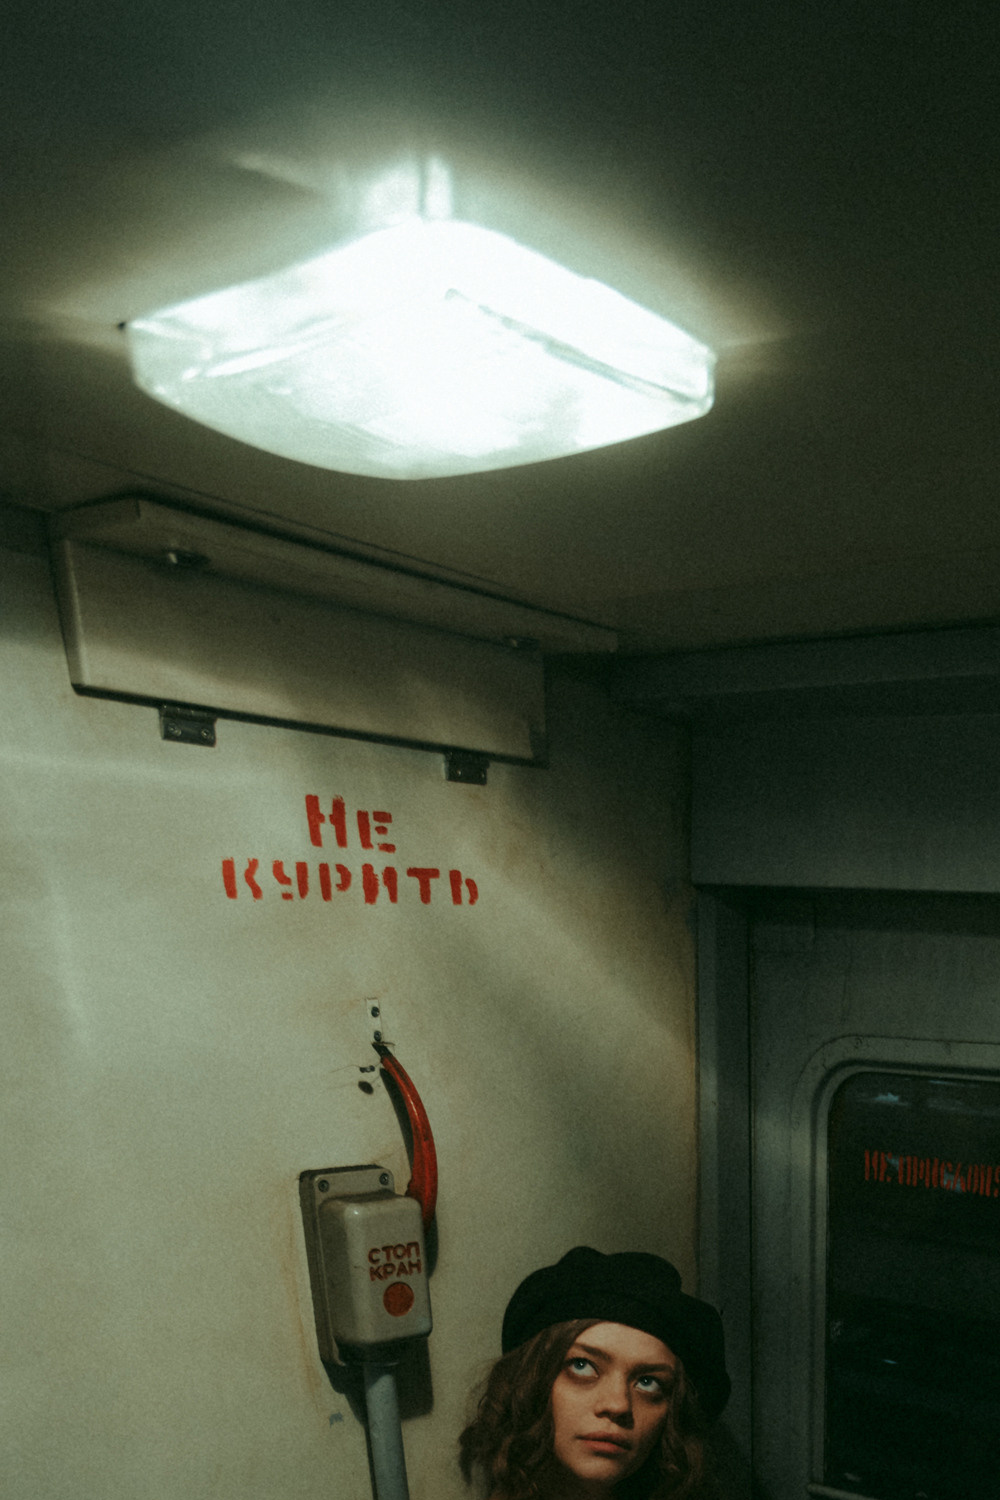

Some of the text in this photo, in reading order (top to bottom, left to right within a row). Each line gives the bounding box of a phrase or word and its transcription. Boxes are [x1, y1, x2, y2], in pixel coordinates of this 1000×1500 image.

[305, 794, 396, 853] НЕ
[221, 857, 479, 905] КУРИТЬ
[368, 1241, 421, 1265] СТОП
[369, 1259, 422, 1282] КРАН
